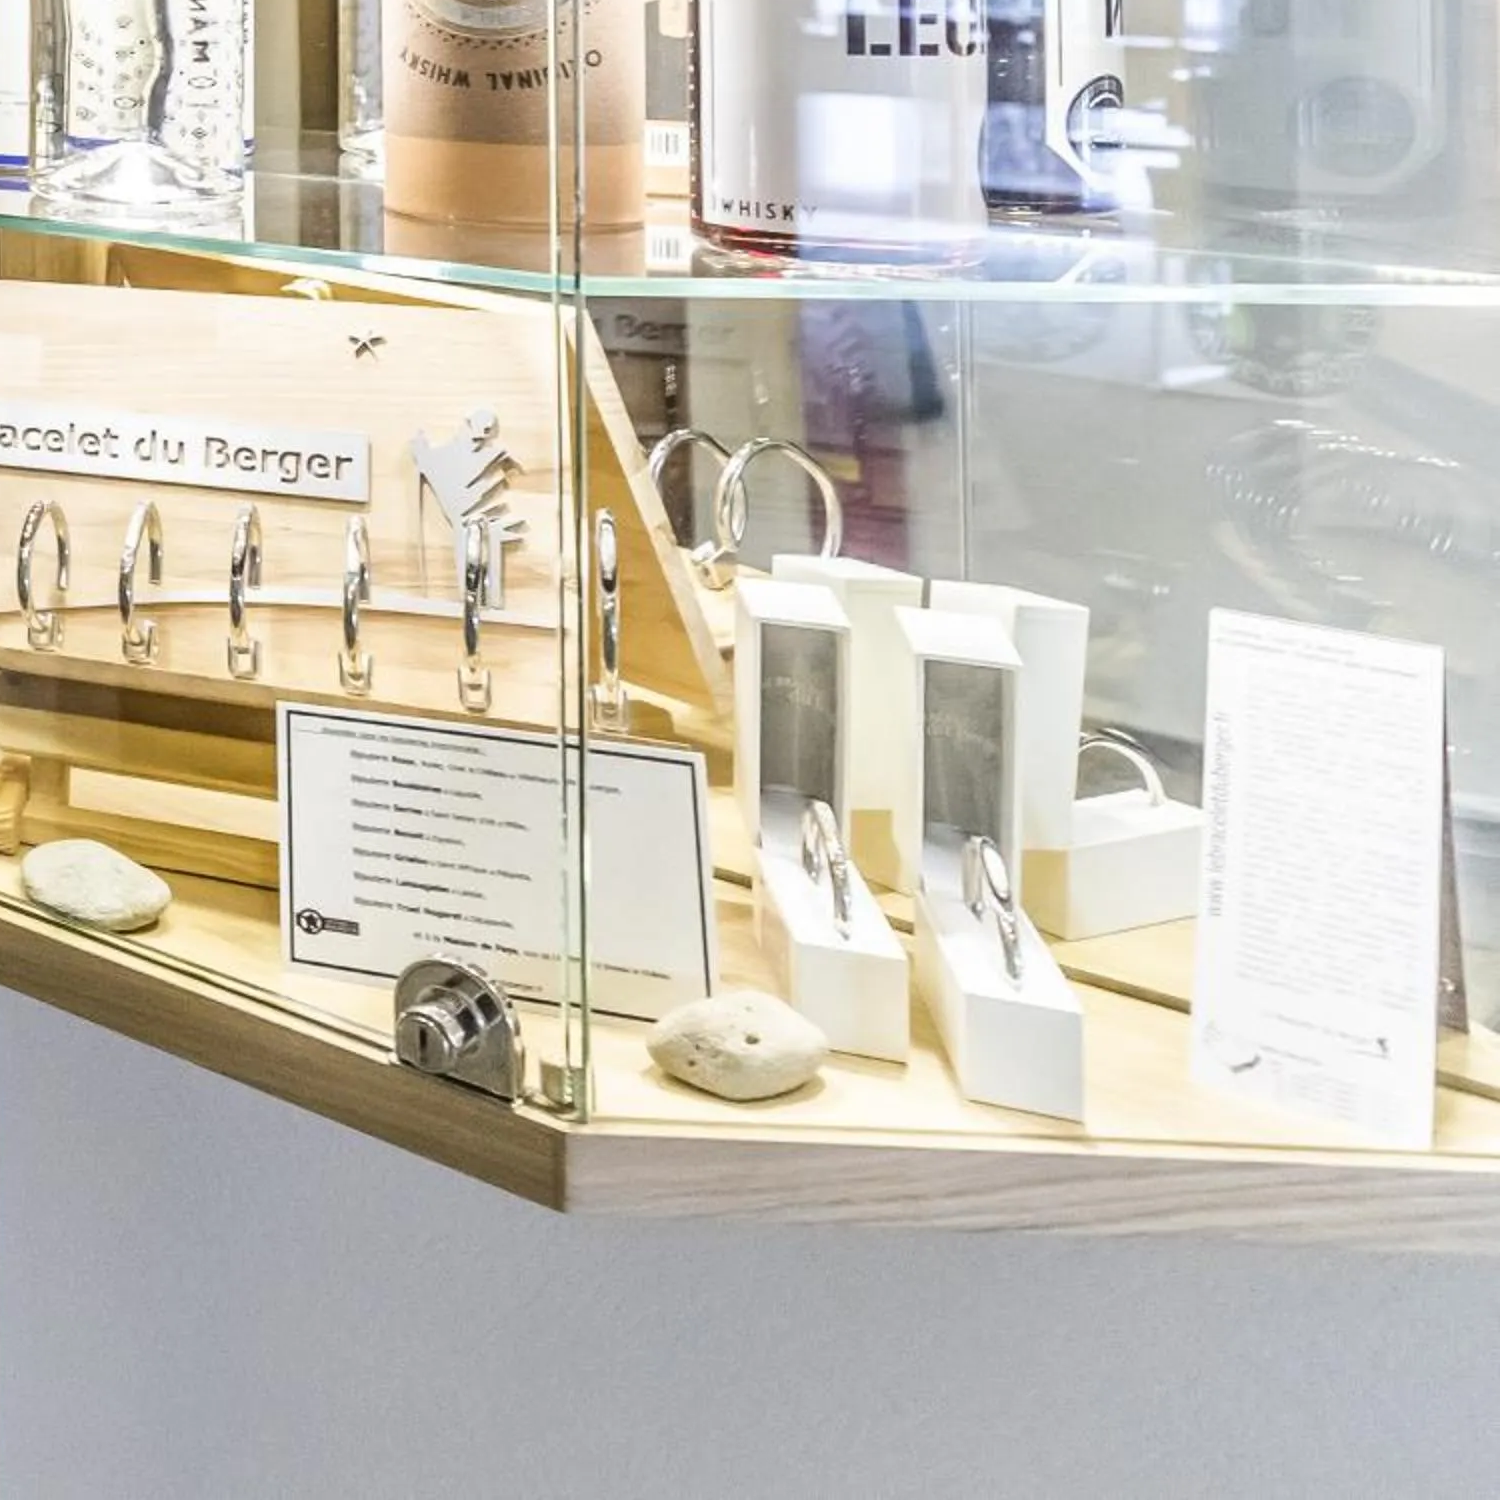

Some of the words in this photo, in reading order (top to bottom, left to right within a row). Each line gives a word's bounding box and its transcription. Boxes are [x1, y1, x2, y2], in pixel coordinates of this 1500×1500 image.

[721, 197, 819, 222] WHISKY
[133, 429, 186, 465] du
[203, 435, 354, 483] Berger
